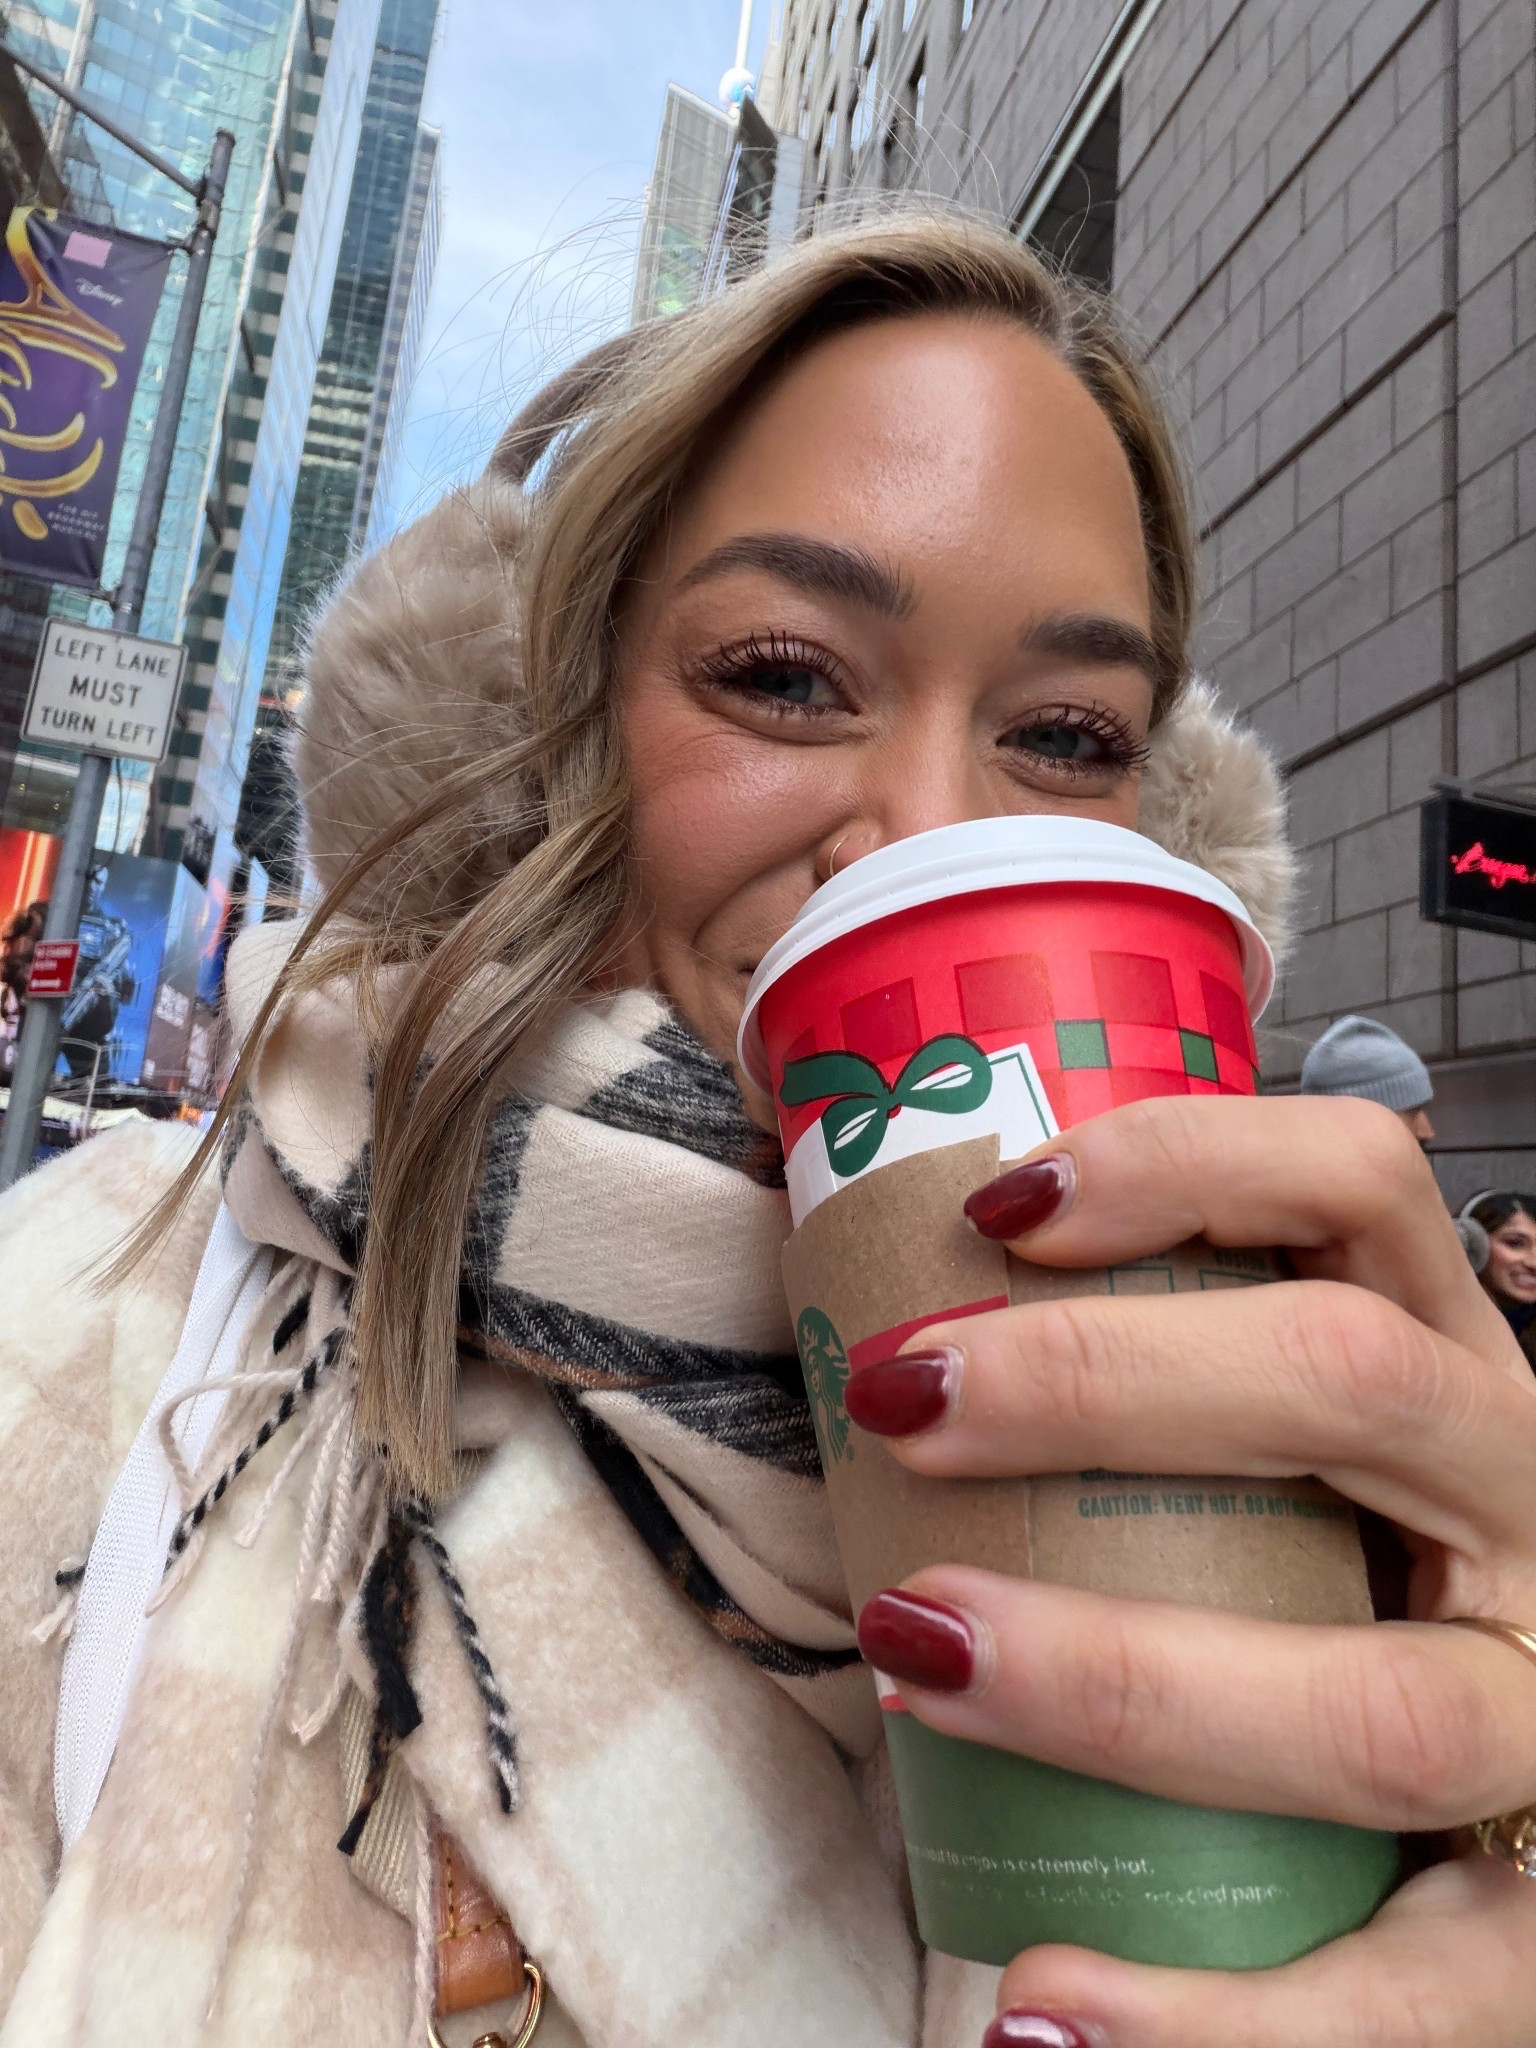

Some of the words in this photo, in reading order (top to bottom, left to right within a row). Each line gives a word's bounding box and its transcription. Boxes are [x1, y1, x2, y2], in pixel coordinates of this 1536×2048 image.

[75, 277, 124, 307] Disney
[54, 636, 105, 664] LEFT
[115, 649, 171, 678] LANE
[69, 673, 142, 708] MUST
[41, 704, 96, 735] TURN
[106, 718, 157, 745] LEFT
[1078, 1494, 1159, 1518] CAUTION:
[1162, 1494, 1204, 1515] VERY
[1209, 1494, 1243, 1516] HOT.
[1018, 1856, 1110, 1878] extremely
[1115, 1855, 1155, 1876] hot.
